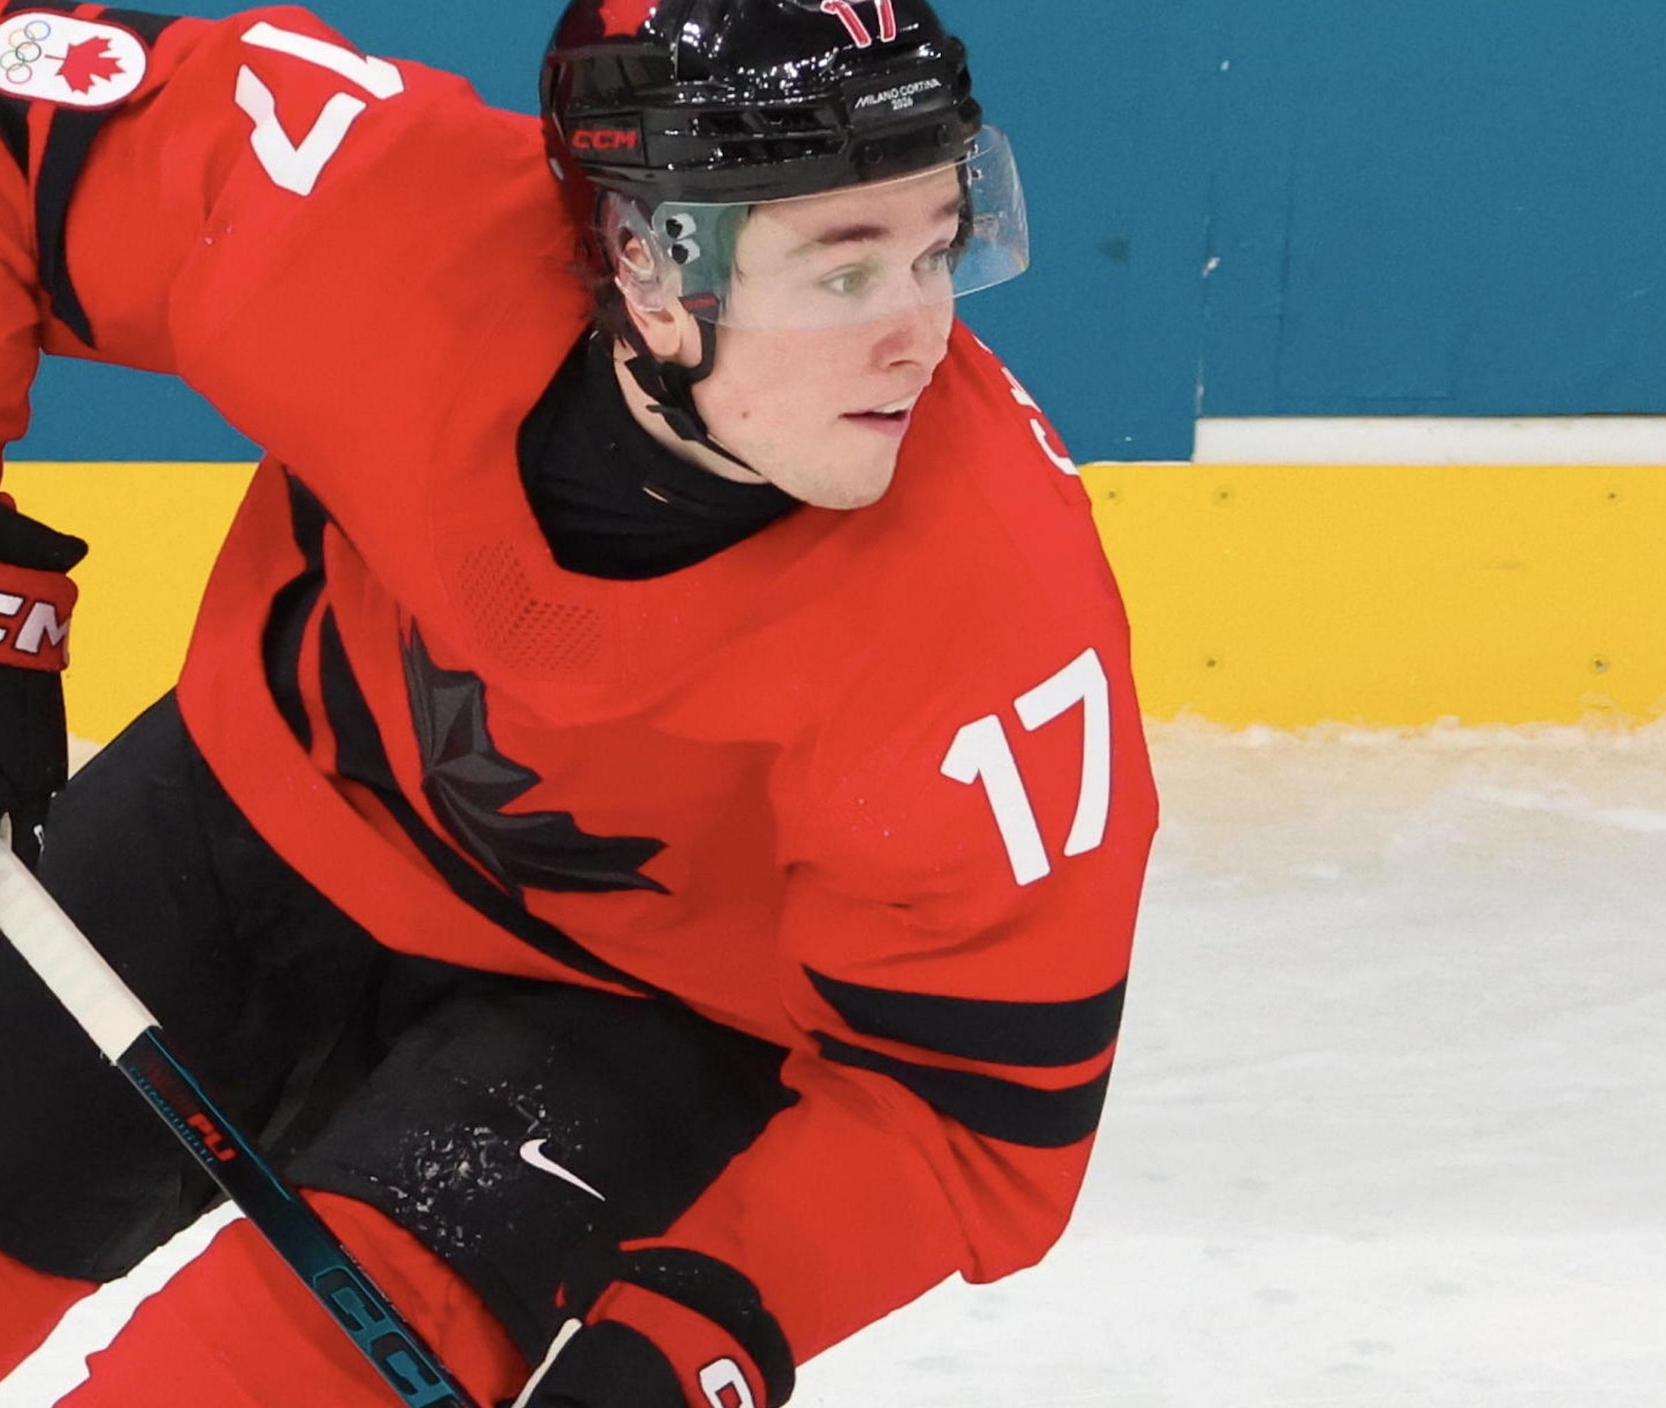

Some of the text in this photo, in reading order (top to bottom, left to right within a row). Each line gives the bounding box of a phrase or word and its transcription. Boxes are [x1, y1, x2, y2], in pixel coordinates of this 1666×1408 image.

[236, 22, 404, 196] 17
[572, 129, 638, 149] CCM
[940, 647, 1111, 886] 17
[313, 1266, 444, 1397] CC
